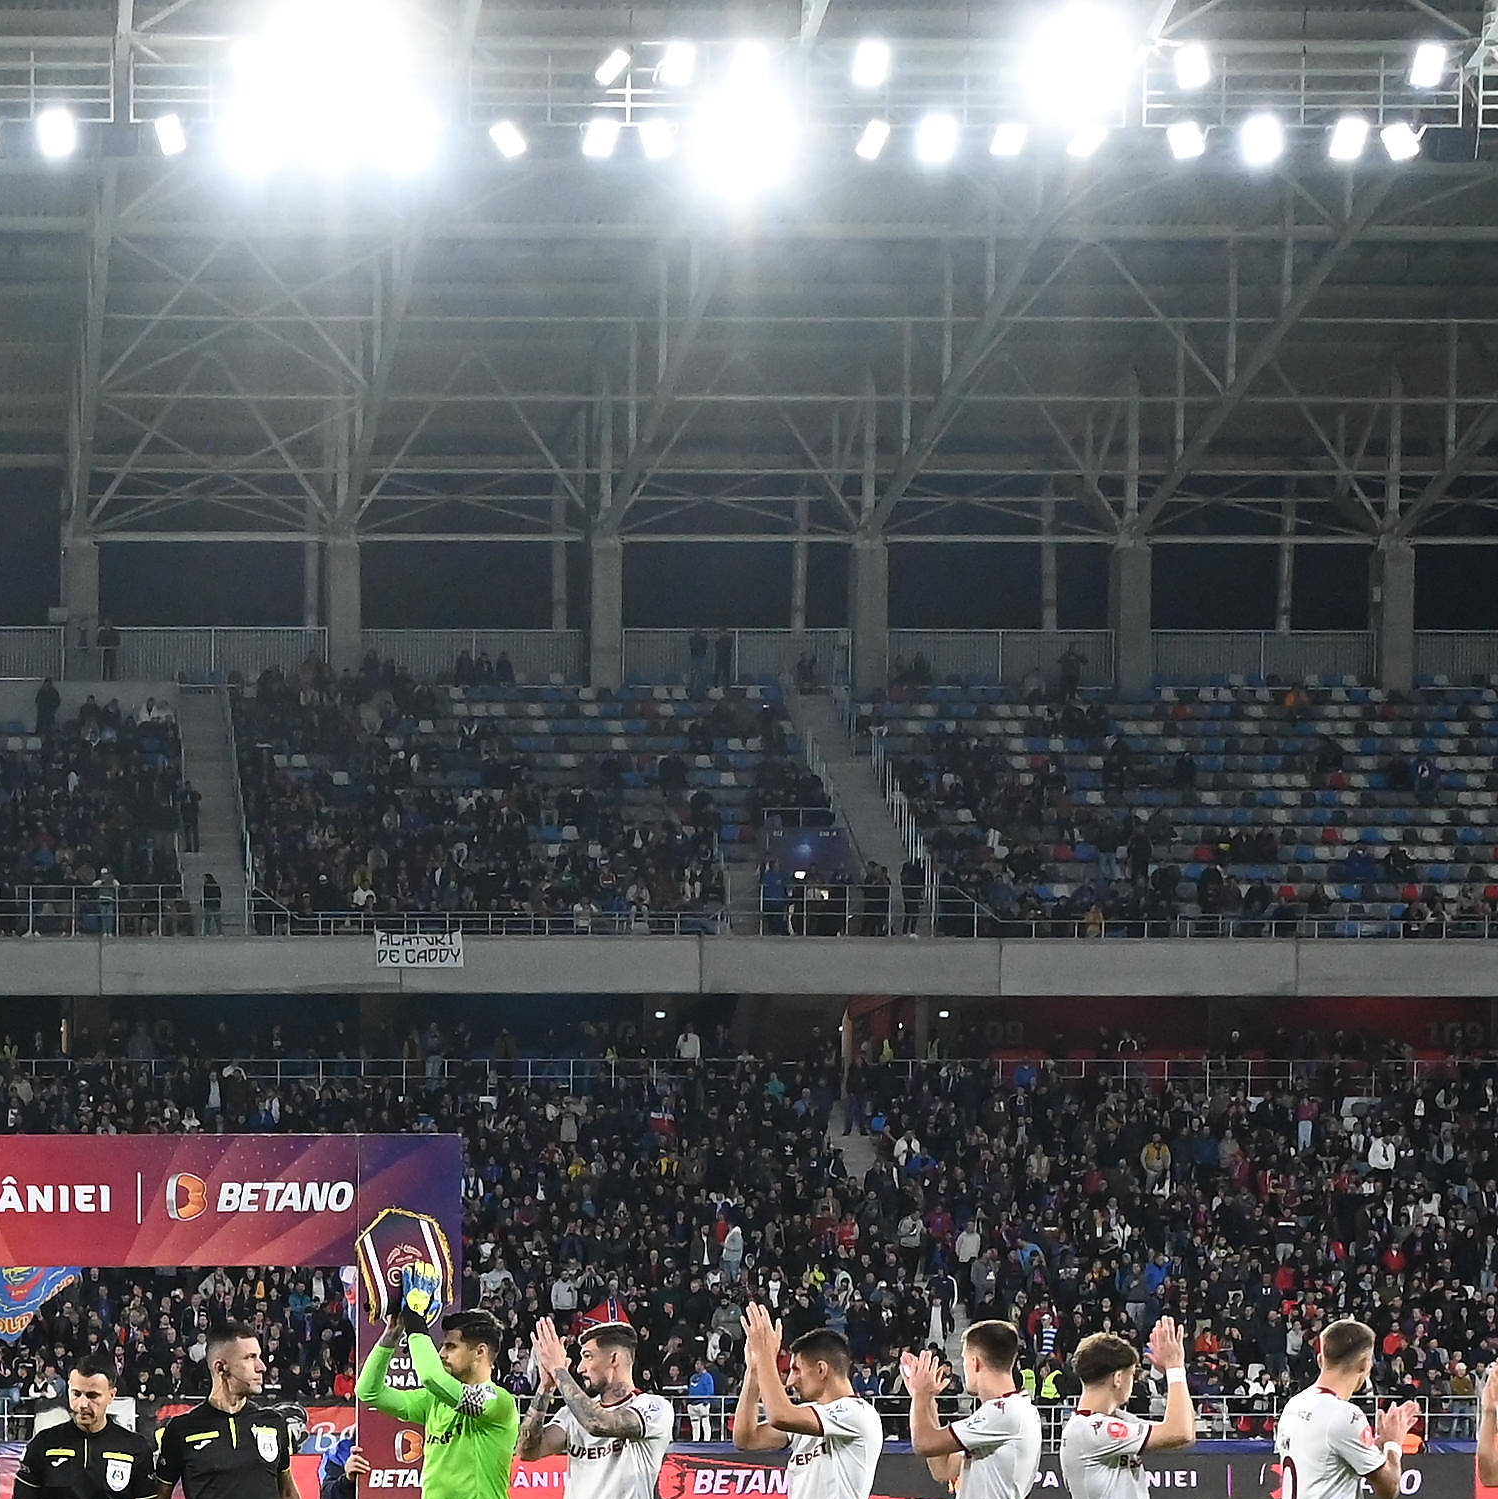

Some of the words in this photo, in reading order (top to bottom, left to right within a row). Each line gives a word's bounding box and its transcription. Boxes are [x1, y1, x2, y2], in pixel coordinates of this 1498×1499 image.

[378, 949, 400, 964] DE
[405, 948, 461, 964] CADDY
[217, 1181, 355, 1212] BETANO
[693, 1469, 789, 1496] BETAN
